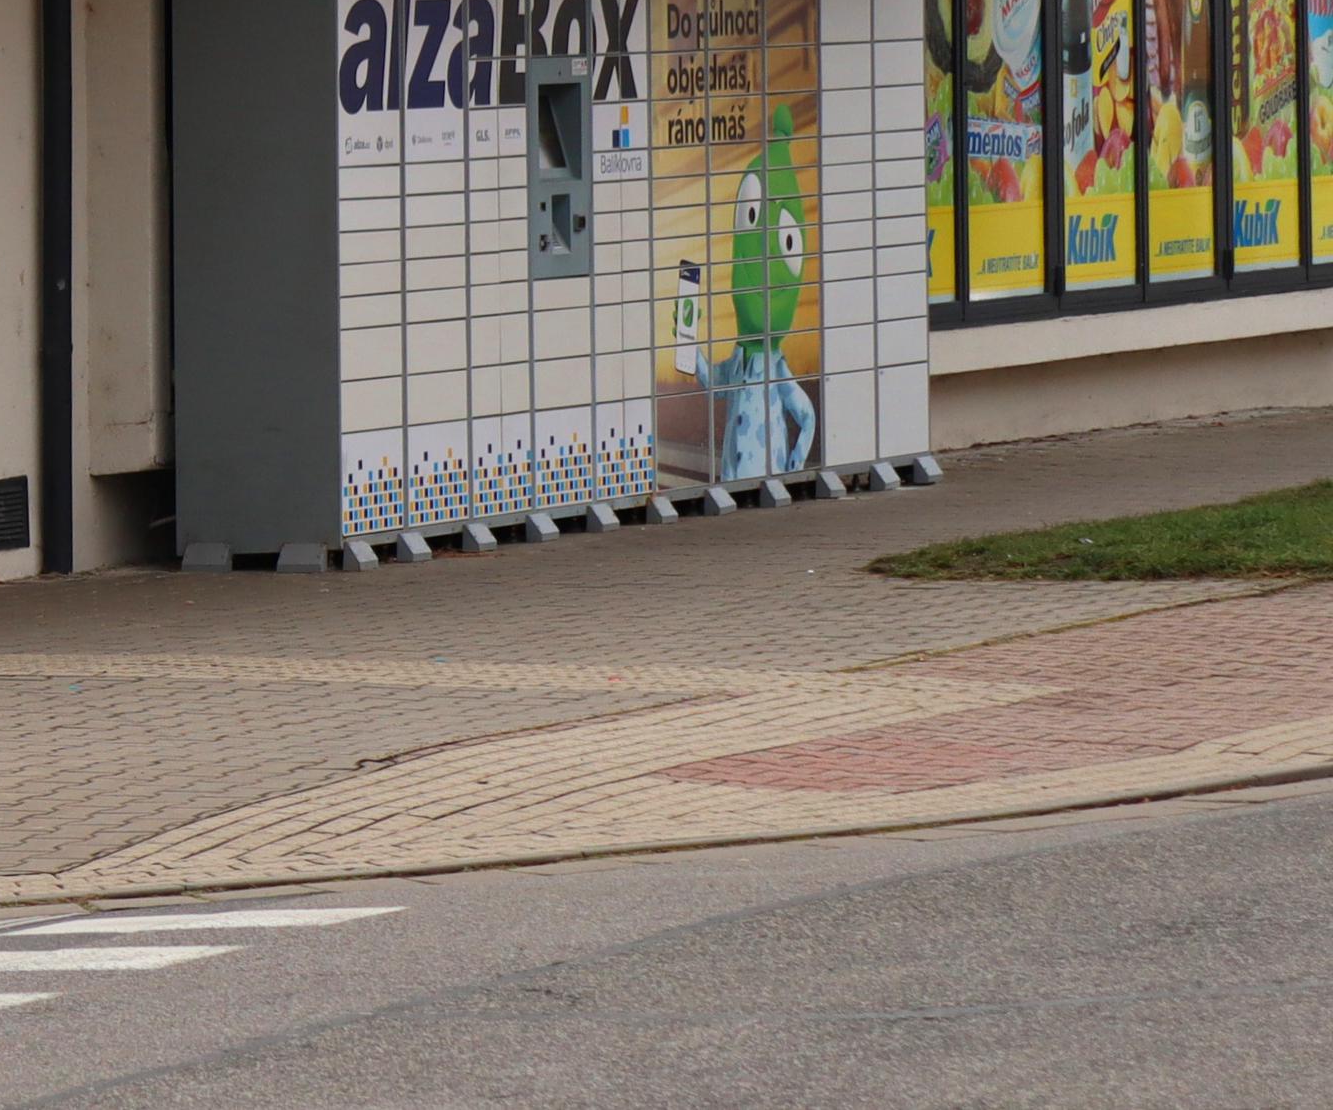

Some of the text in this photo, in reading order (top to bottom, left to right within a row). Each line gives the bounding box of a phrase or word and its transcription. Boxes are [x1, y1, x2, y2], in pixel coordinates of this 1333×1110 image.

[667, 3, 692, 40] Do
[667, 53, 751, 103] objednáš,
[668, 103, 747, 145] ráno máš
[967, 129, 1023, 158] mentos
[1065, 96, 1090, 153] ofola
